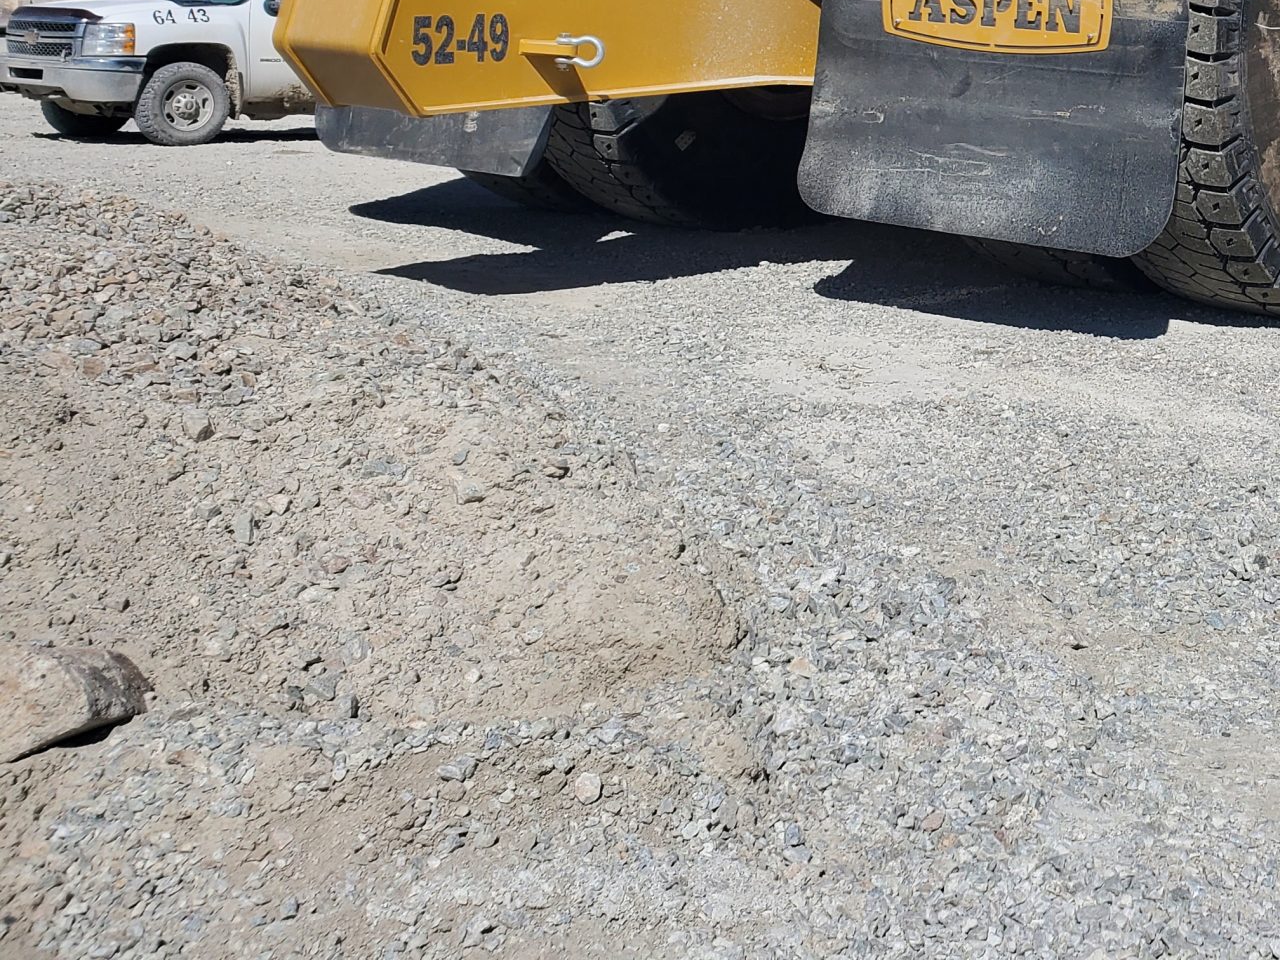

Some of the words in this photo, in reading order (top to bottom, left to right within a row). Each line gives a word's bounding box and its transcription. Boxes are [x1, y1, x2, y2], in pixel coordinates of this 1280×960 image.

[152, 9, 177, 25] 64
[187, 8, 211, 23] 43
[411, 13, 510, 66] 52-49
